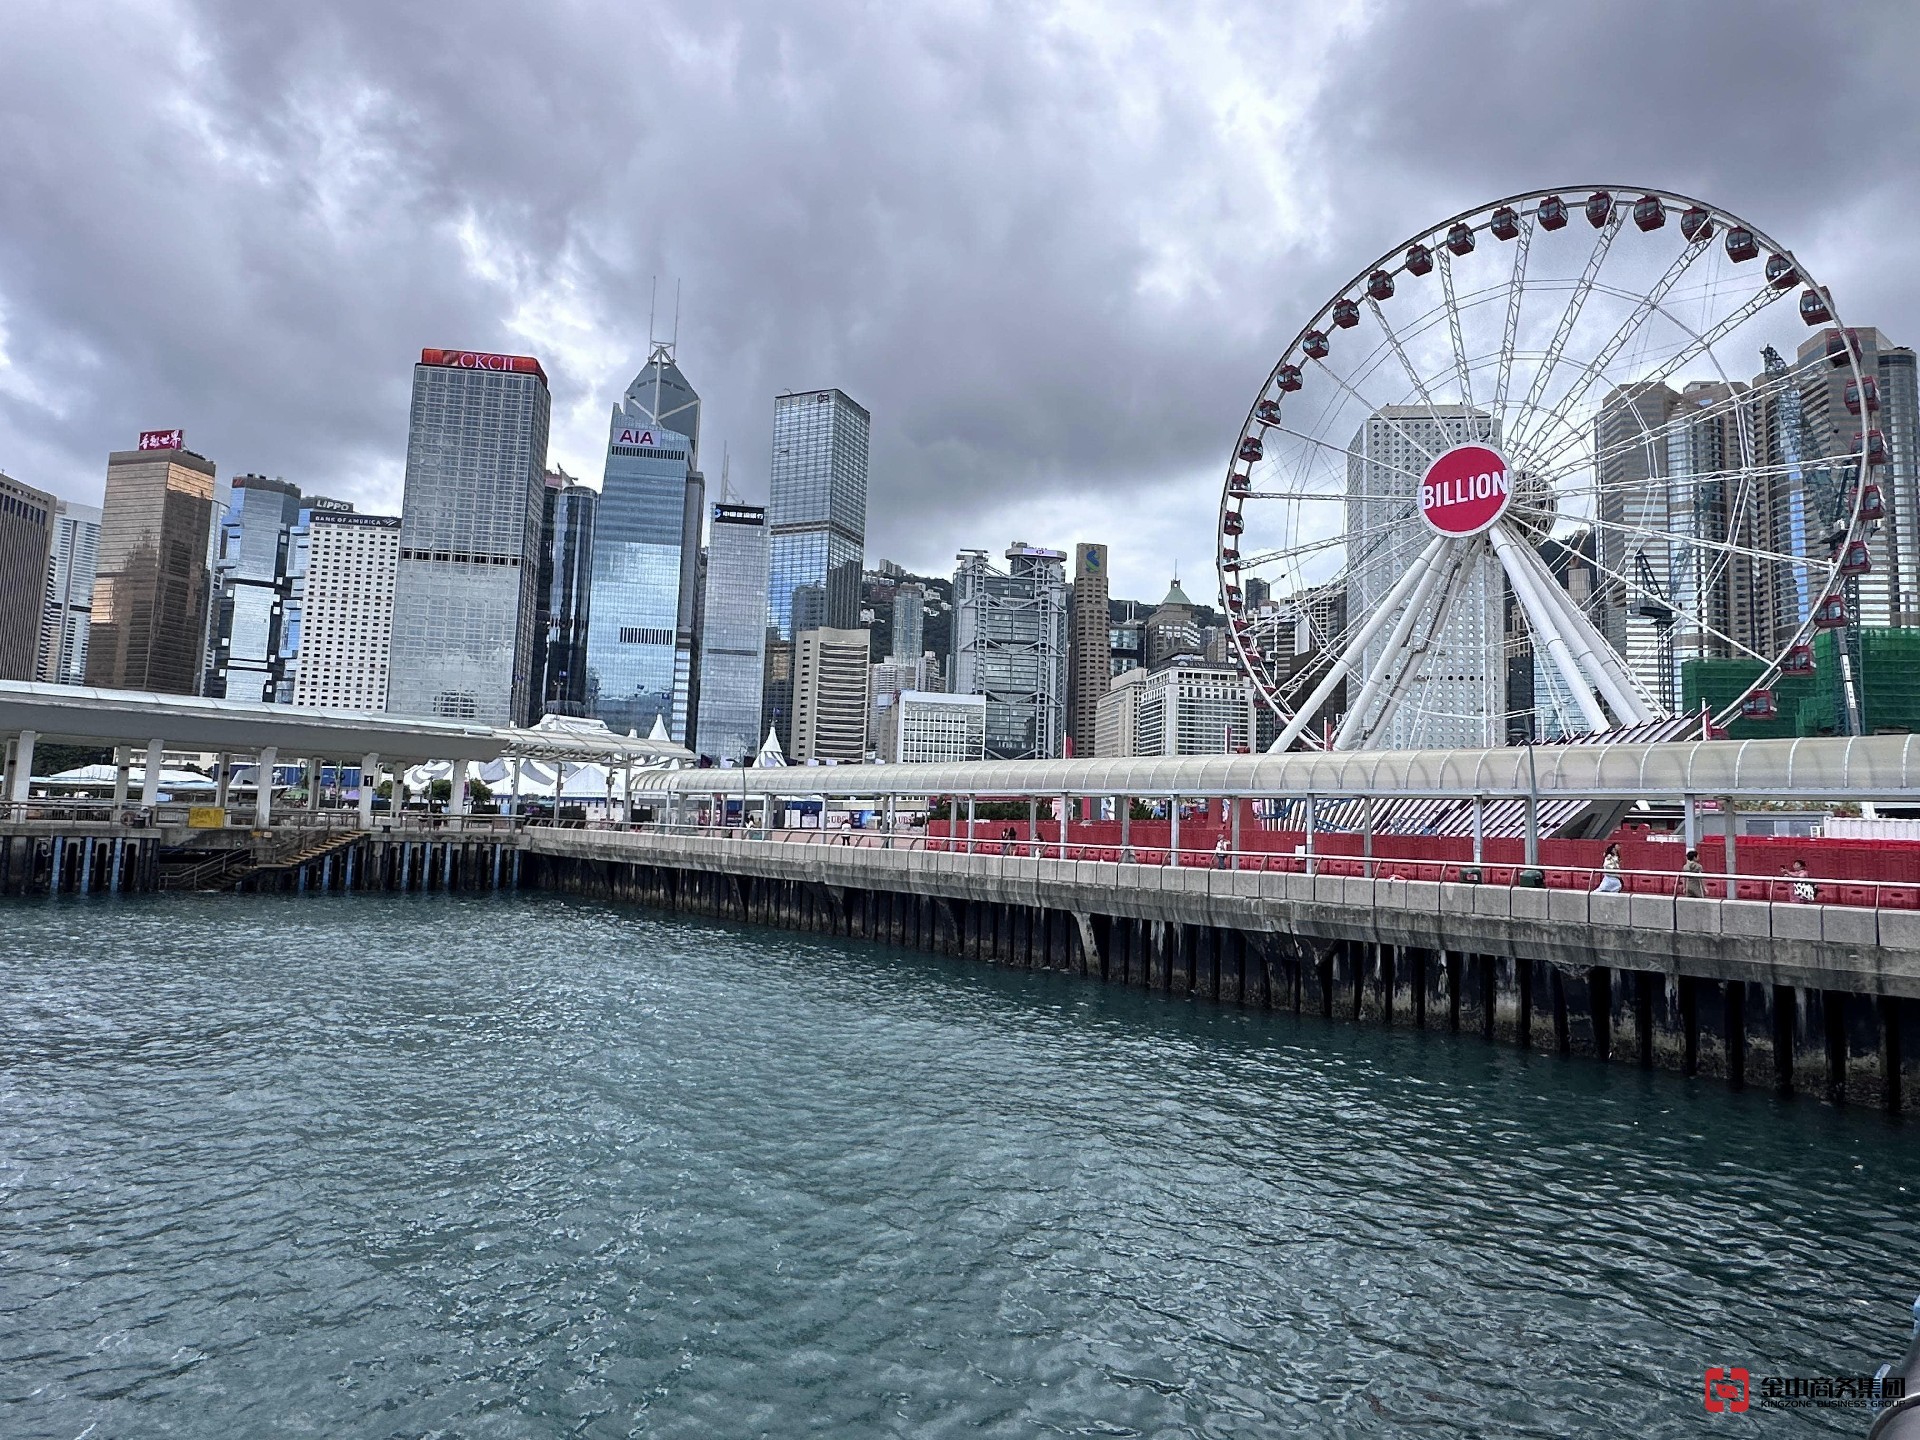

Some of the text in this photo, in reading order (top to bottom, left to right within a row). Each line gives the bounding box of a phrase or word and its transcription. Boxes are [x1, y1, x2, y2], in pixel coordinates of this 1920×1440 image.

[460, 353, 515, 371] CKCII
[619, 429, 654, 445] AIA
[1421, 469, 1508, 510] BILLION
[316, 499, 350, 511] LIPPO
[315, 515, 336, 523] BANK
